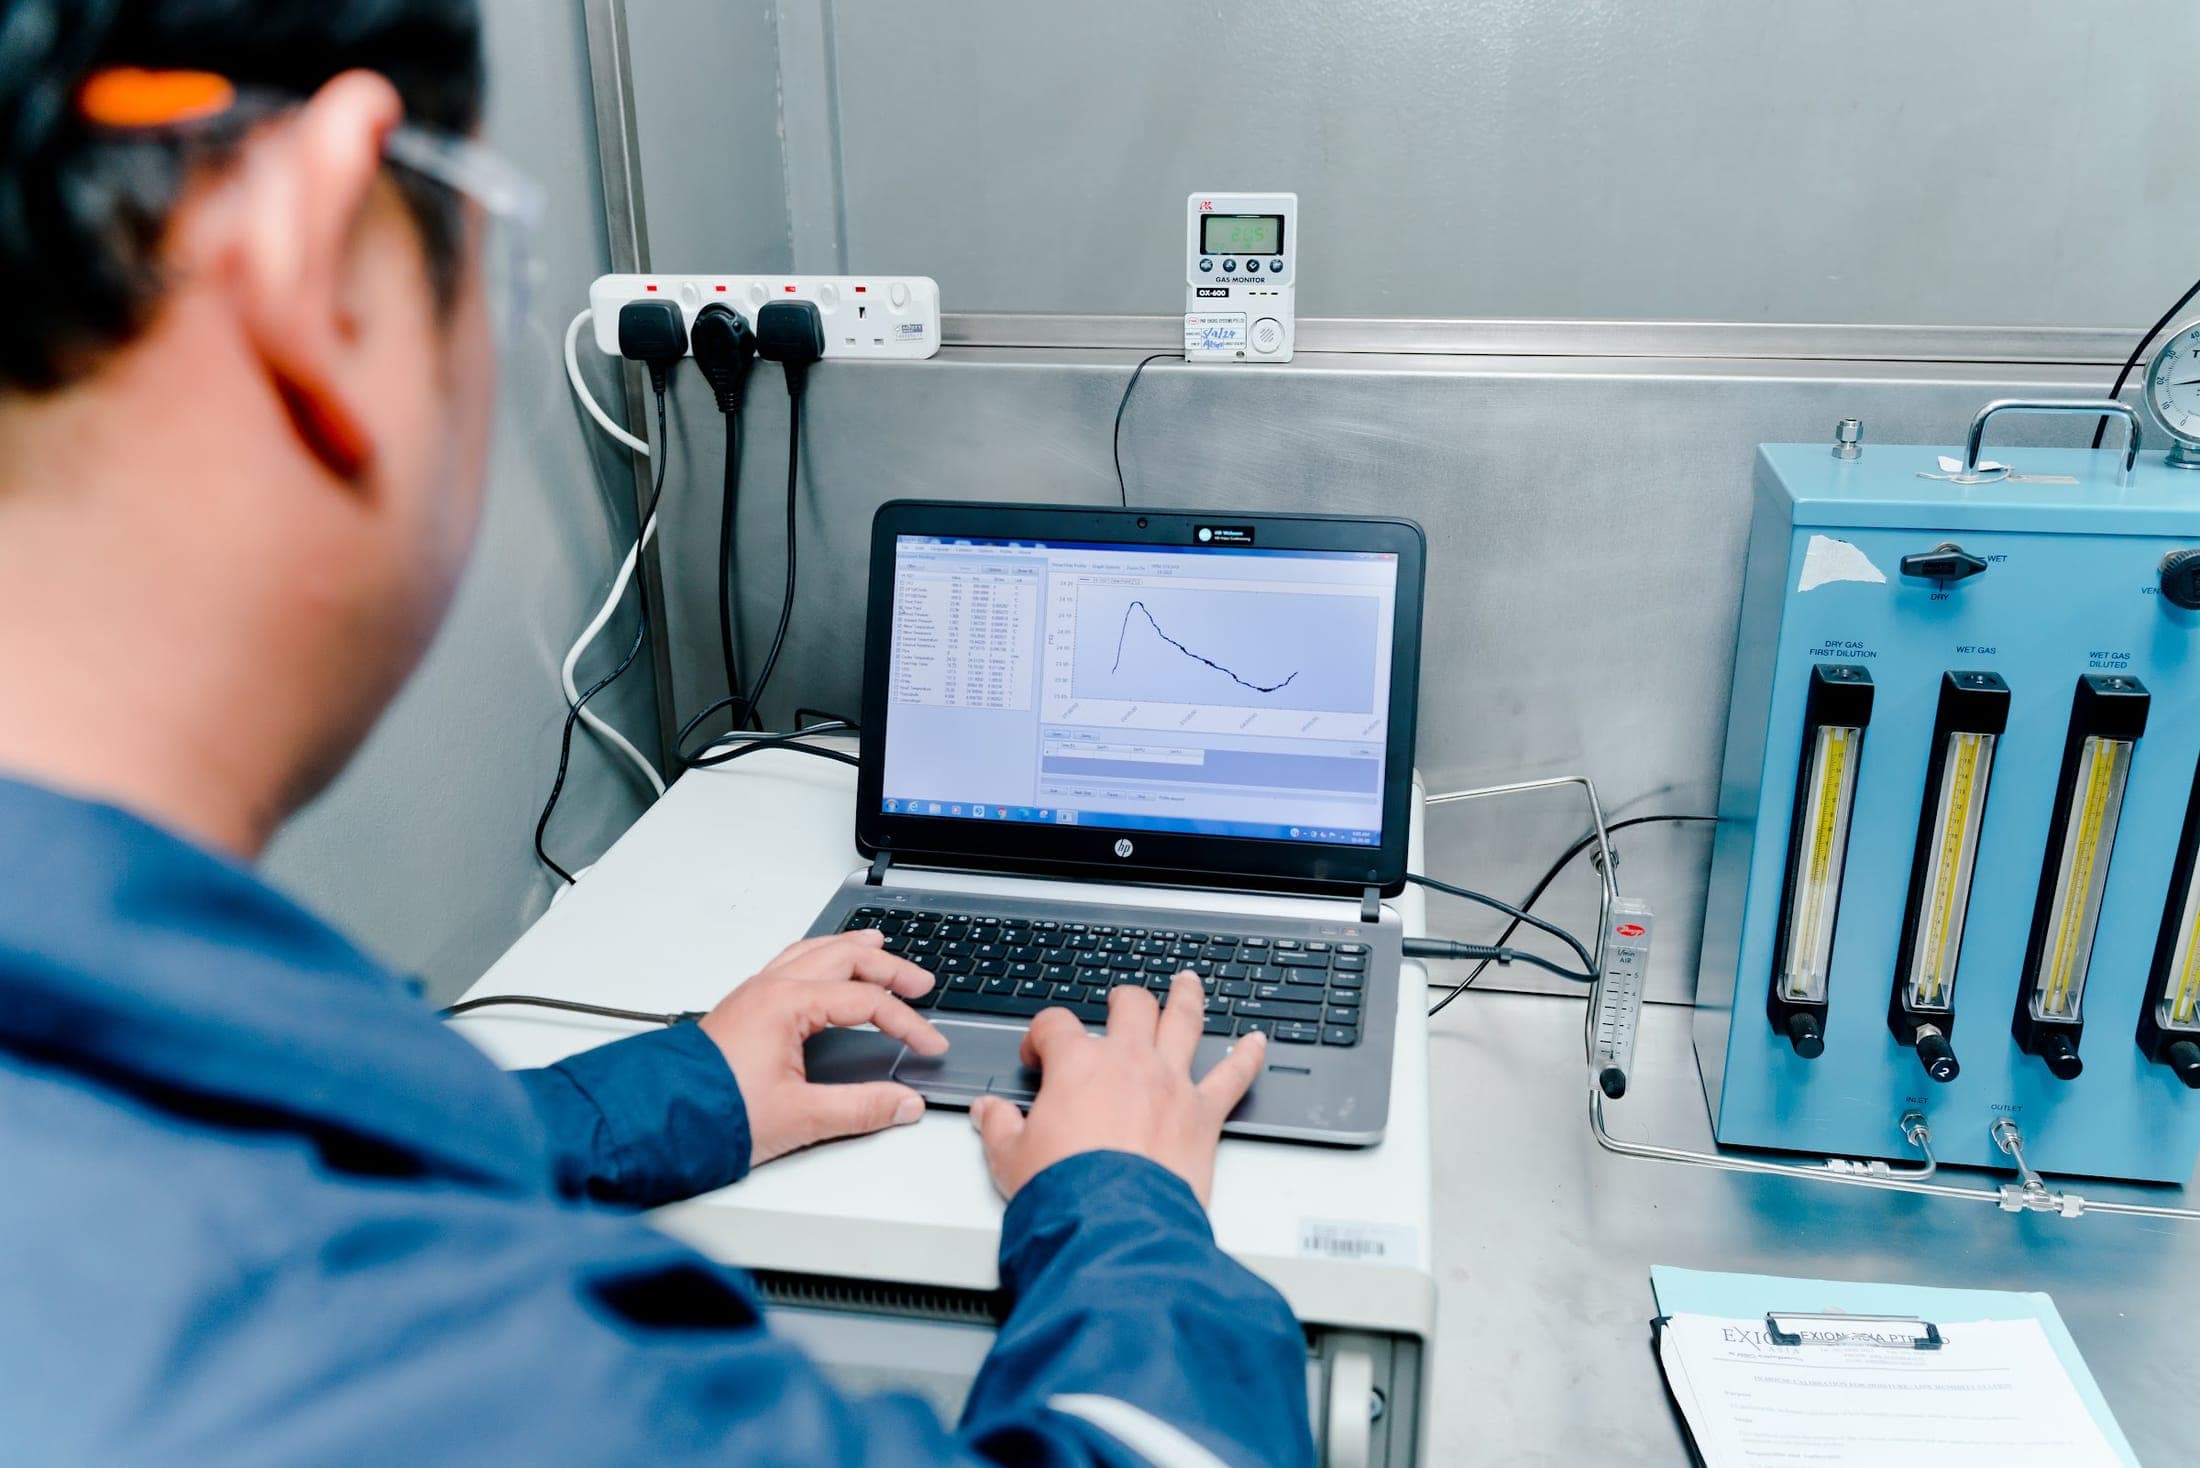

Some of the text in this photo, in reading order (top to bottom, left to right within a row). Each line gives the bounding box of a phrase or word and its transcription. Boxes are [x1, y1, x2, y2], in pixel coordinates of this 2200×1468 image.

[1199, 289, 1226, 297] OX-600
[2156, 376, 2165, 385] 20
[1987, 555, 2007, 563] WET
[2141, 587, 2162, 595] VEN
[1825, 640, 1843, 648] DRY
[1836, 650, 1877, 658] DILUTION
[1956, 646, 1976, 654] WET
[2089, 651, 2130, 660] WET GAS
[2089, 661, 2127, 669] DILUTED
[1905, 1096, 1928, 1104] INLET
[1990, 1103, 2023, 1112] OUTLET
